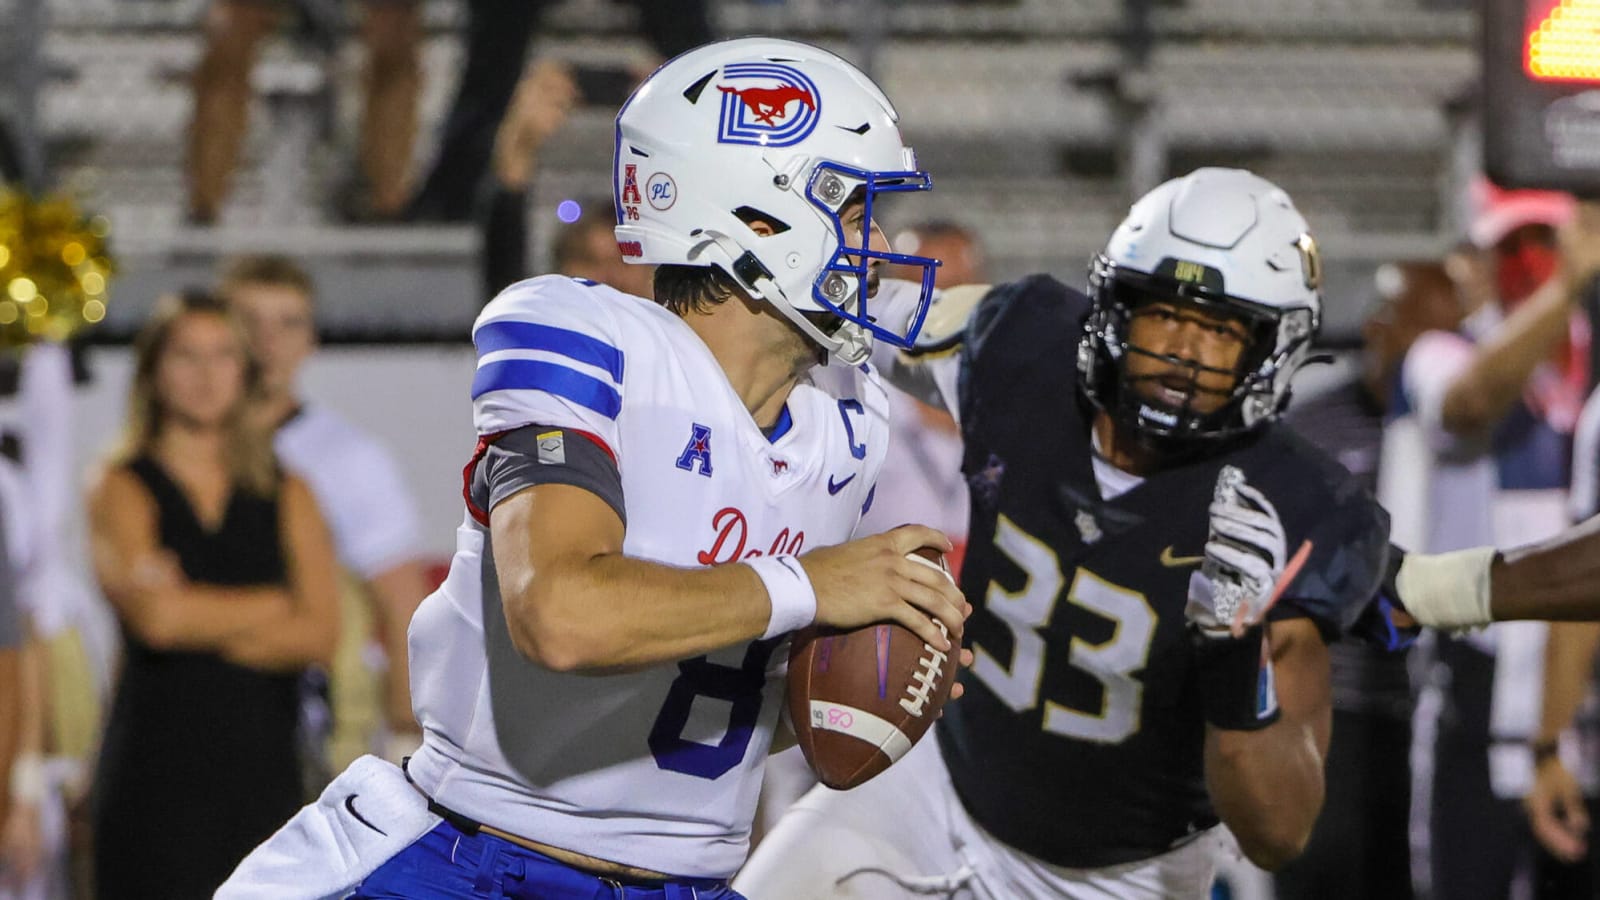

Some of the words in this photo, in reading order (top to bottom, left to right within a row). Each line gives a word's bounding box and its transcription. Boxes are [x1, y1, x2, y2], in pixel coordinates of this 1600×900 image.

[652, 182, 671, 200] PL
[676, 423, 713, 477] A
[838, 399, 866, 460] C
[971, 513, 1160, 745] 33
[648, 632, 790, 781] 8
